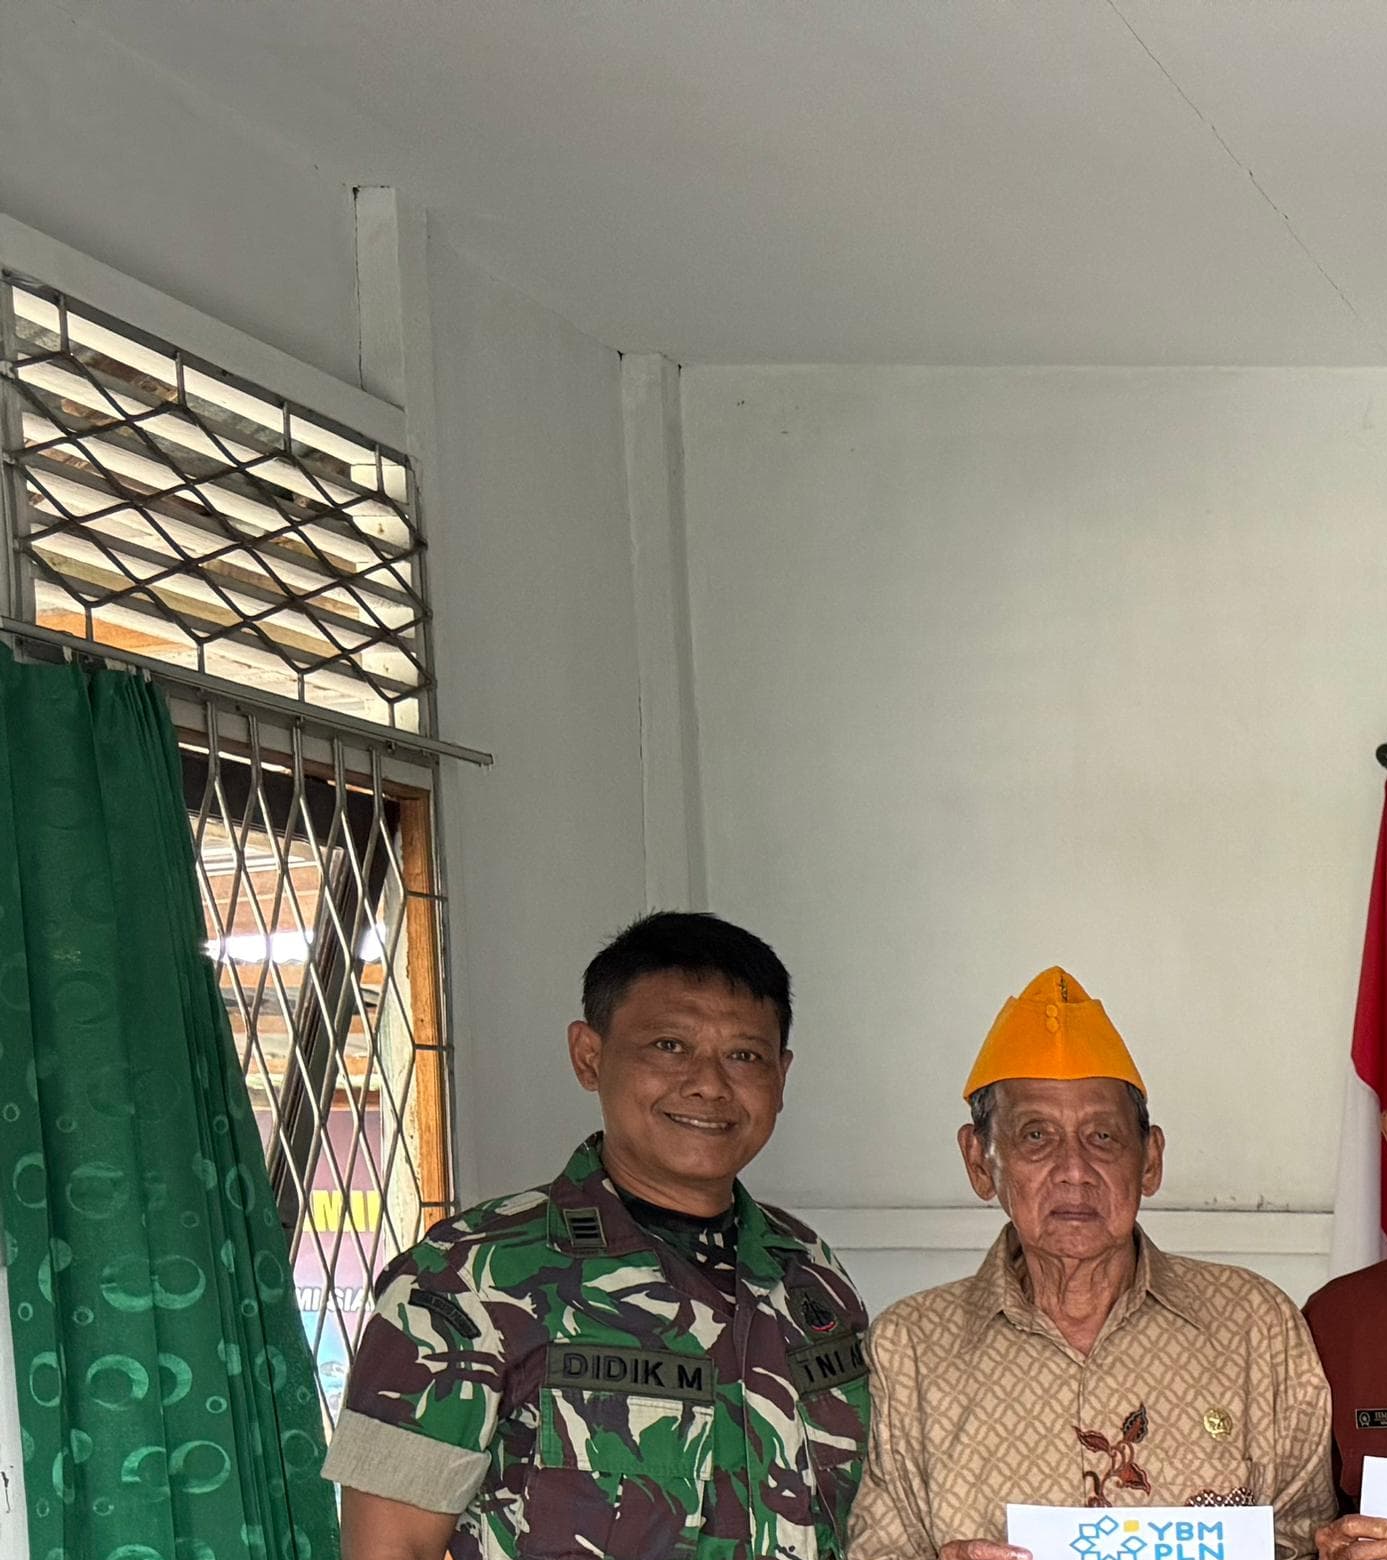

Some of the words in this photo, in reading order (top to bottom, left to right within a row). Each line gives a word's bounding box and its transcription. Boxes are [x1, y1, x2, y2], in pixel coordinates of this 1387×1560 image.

[563, 1351, 664, 1387] DIDIK
[677, 1363, 703, 1391] M
[796, 1350, 846, 1383] TNI
[1148, 1521, 1224, 1541] YBM
